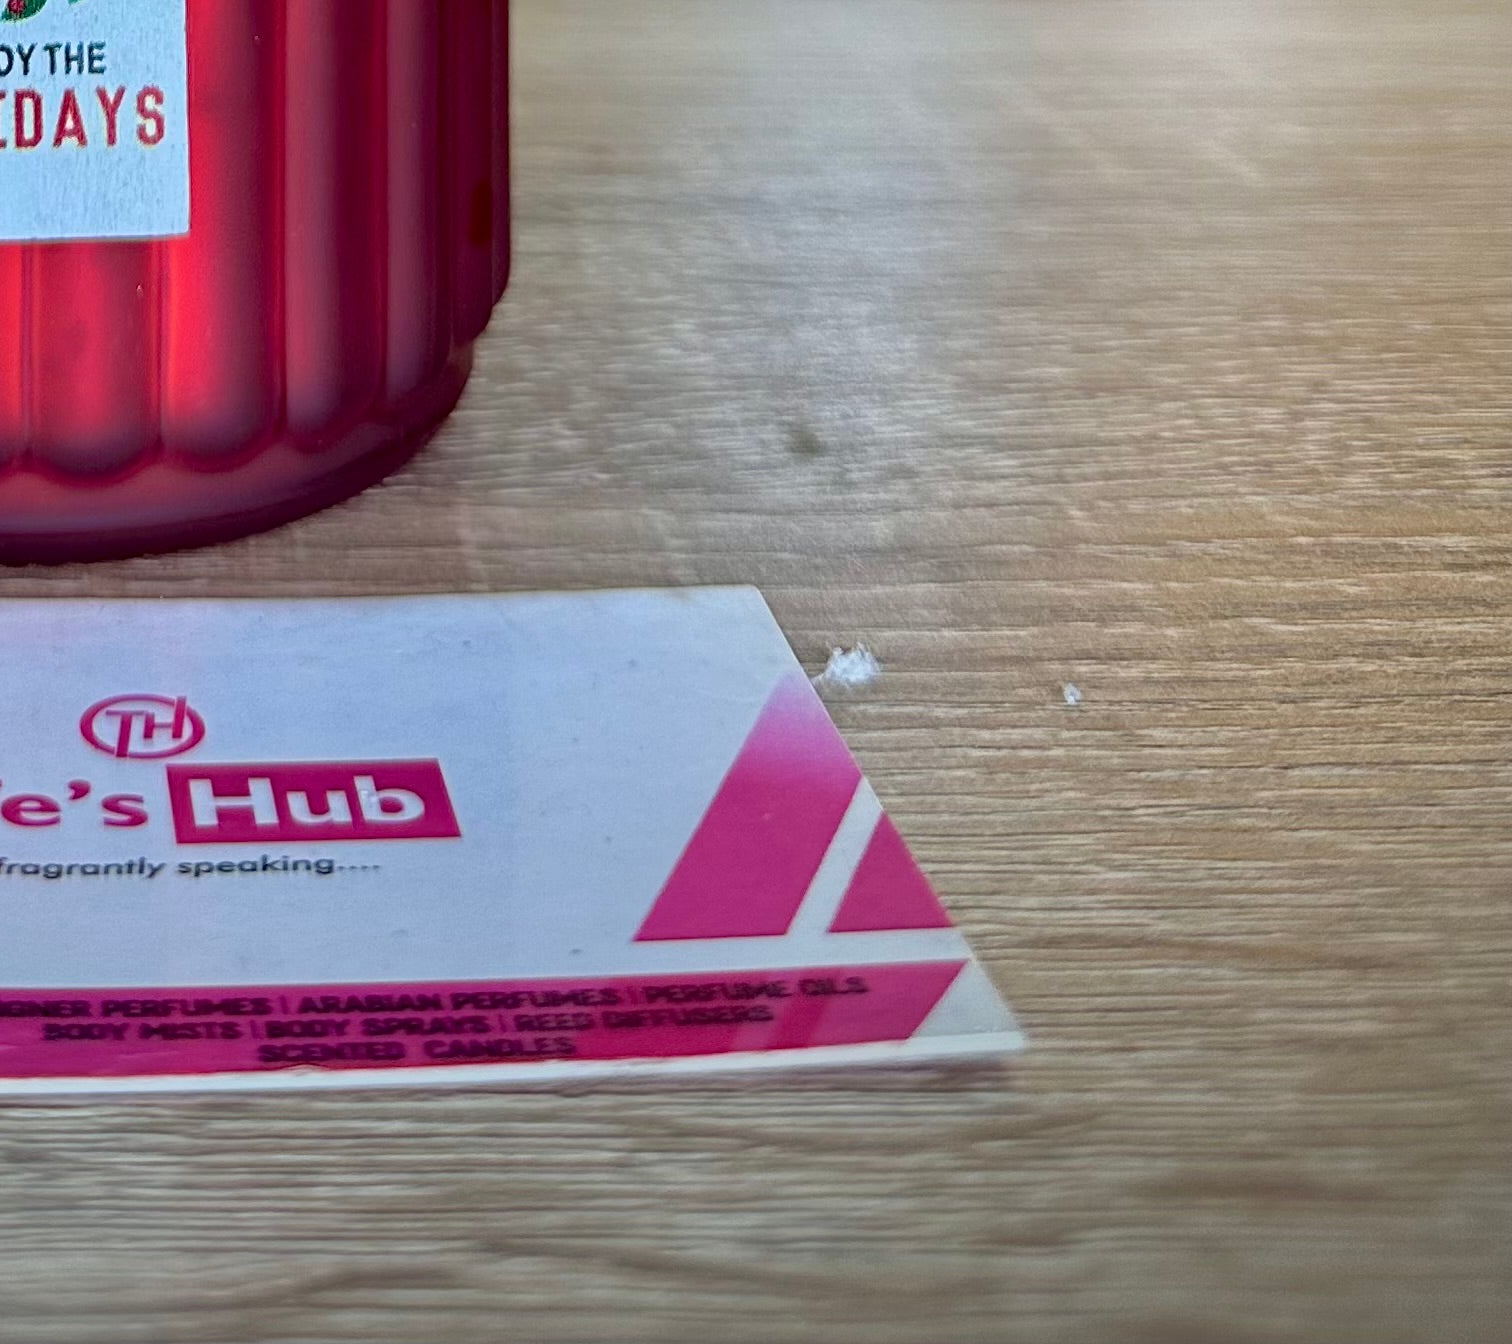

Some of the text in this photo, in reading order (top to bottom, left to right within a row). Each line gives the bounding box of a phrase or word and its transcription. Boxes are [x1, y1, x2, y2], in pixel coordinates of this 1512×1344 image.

[43, 41, 107, 75] THE
[187, 774, 427, 828] Hub
[297, 993, 443, 1013] ARABIAN
[44, 1022, 130, 1041] BODY
[265, 1018, 350, 1038] BODY
